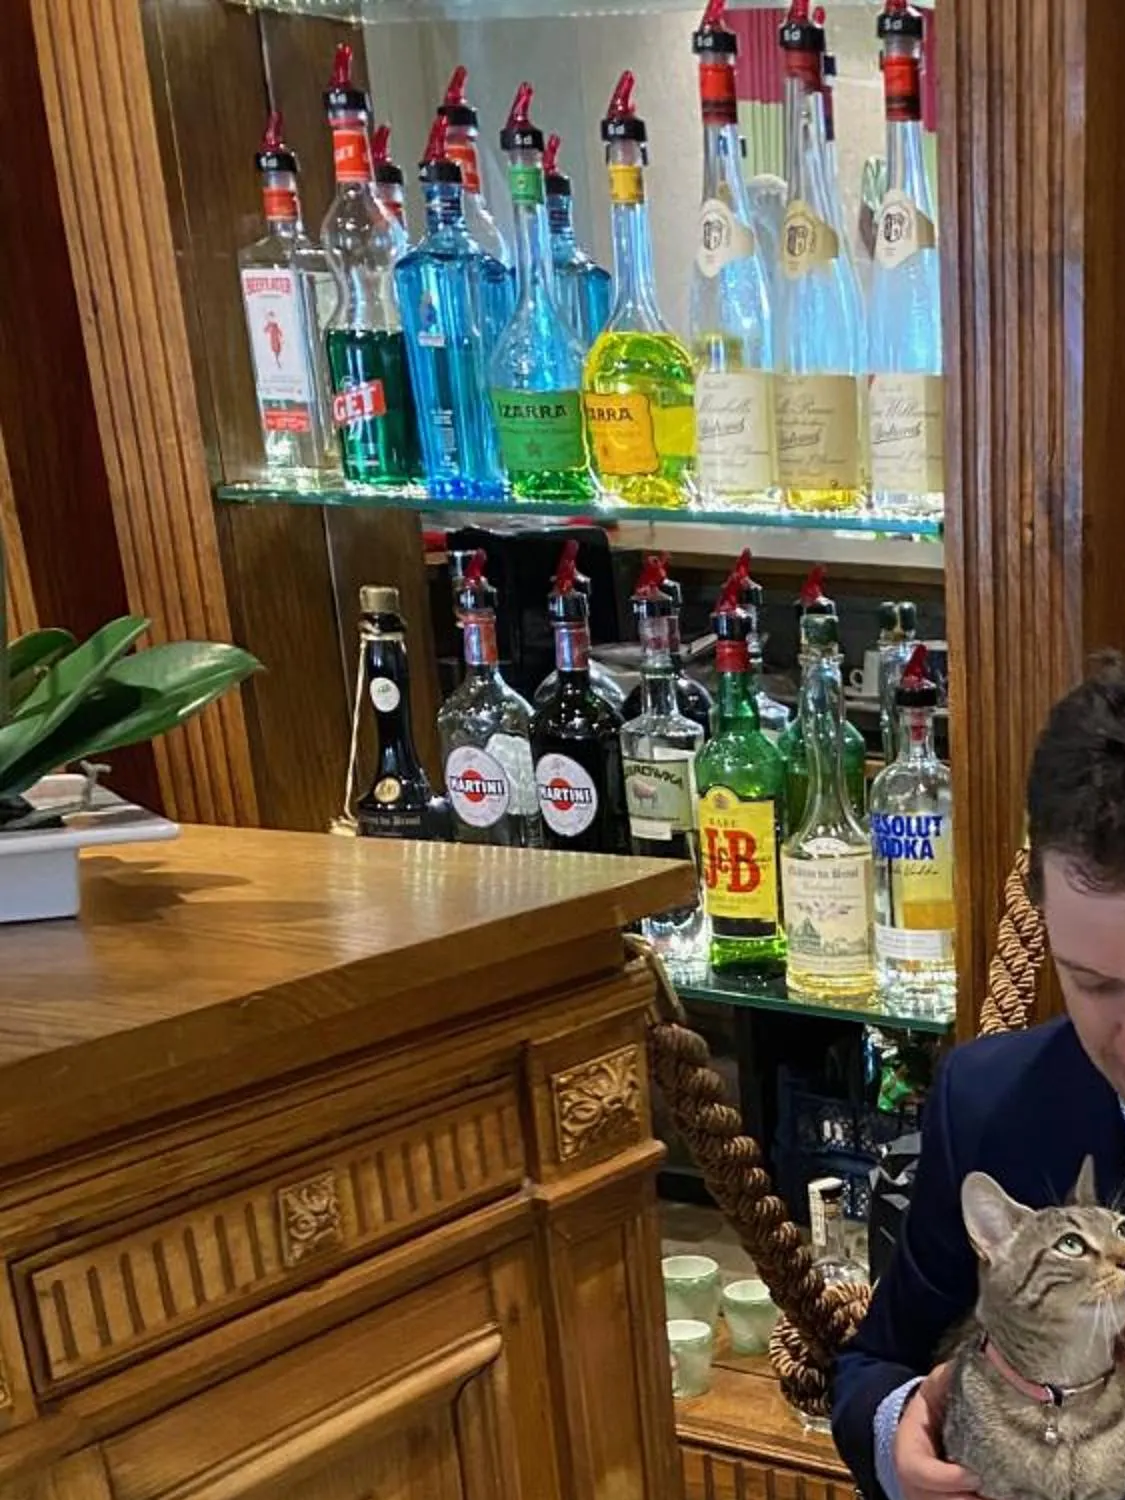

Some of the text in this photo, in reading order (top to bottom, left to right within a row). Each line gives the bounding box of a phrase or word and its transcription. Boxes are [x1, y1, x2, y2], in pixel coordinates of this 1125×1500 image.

[333, 384, 376, 423] GET
[450, 775, 505, 796] MARTINI
[537, 783, 592, 804] MARTINI
